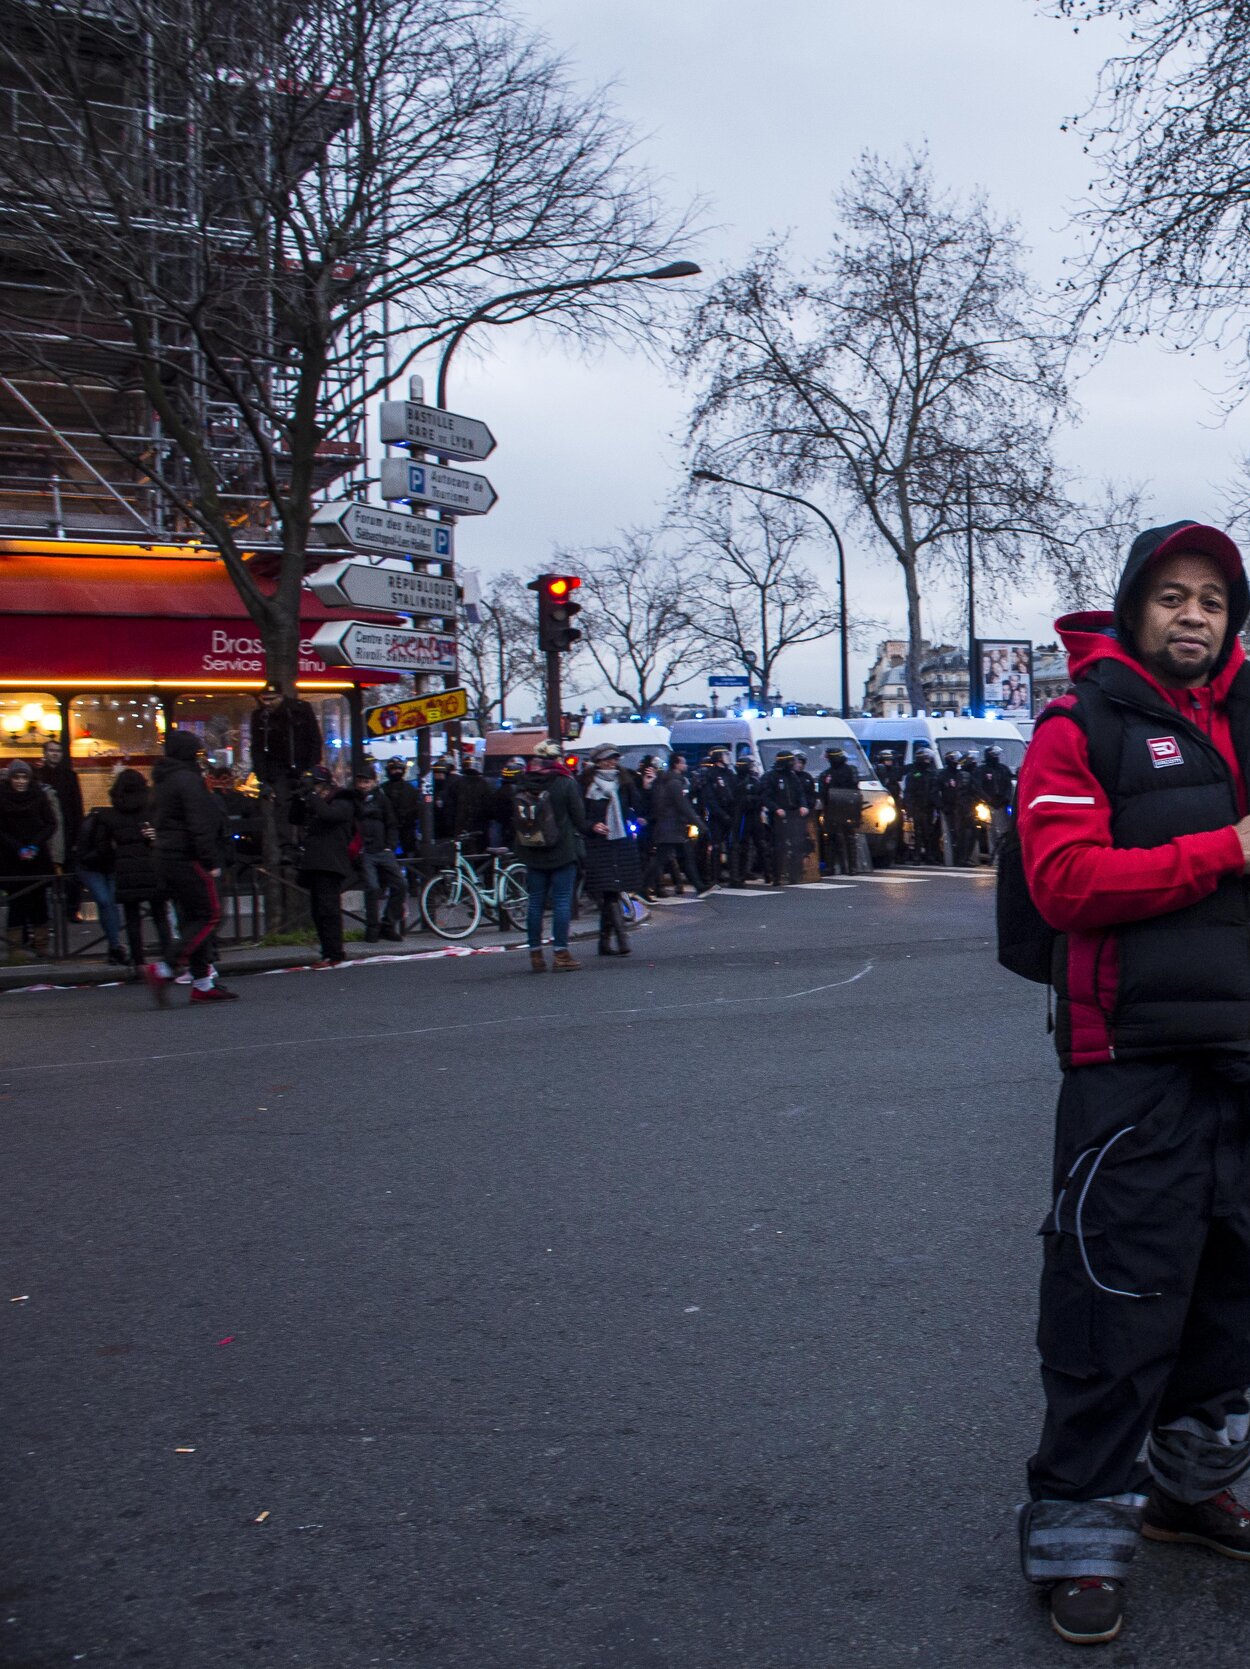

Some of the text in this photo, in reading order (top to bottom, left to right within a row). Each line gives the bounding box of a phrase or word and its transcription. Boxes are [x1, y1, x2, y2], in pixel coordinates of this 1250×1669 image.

[407, 408, 454, 431] BASTILLE
[408, 423, 435, 440] GARE
[451, 435, 475, 450] LYON
[431, 485, 470, 504] Tourisme
[473, 481, 484, 493] de
[355, 510, 383, 527] Forum
[386, 518, 402, 530] des
[404, 521, 432, 537] Halles
[391, 592, 453, 611] STALINGRAD
[355, 631, 382, 645] Centre
[202, 655, 262, 671] Service
